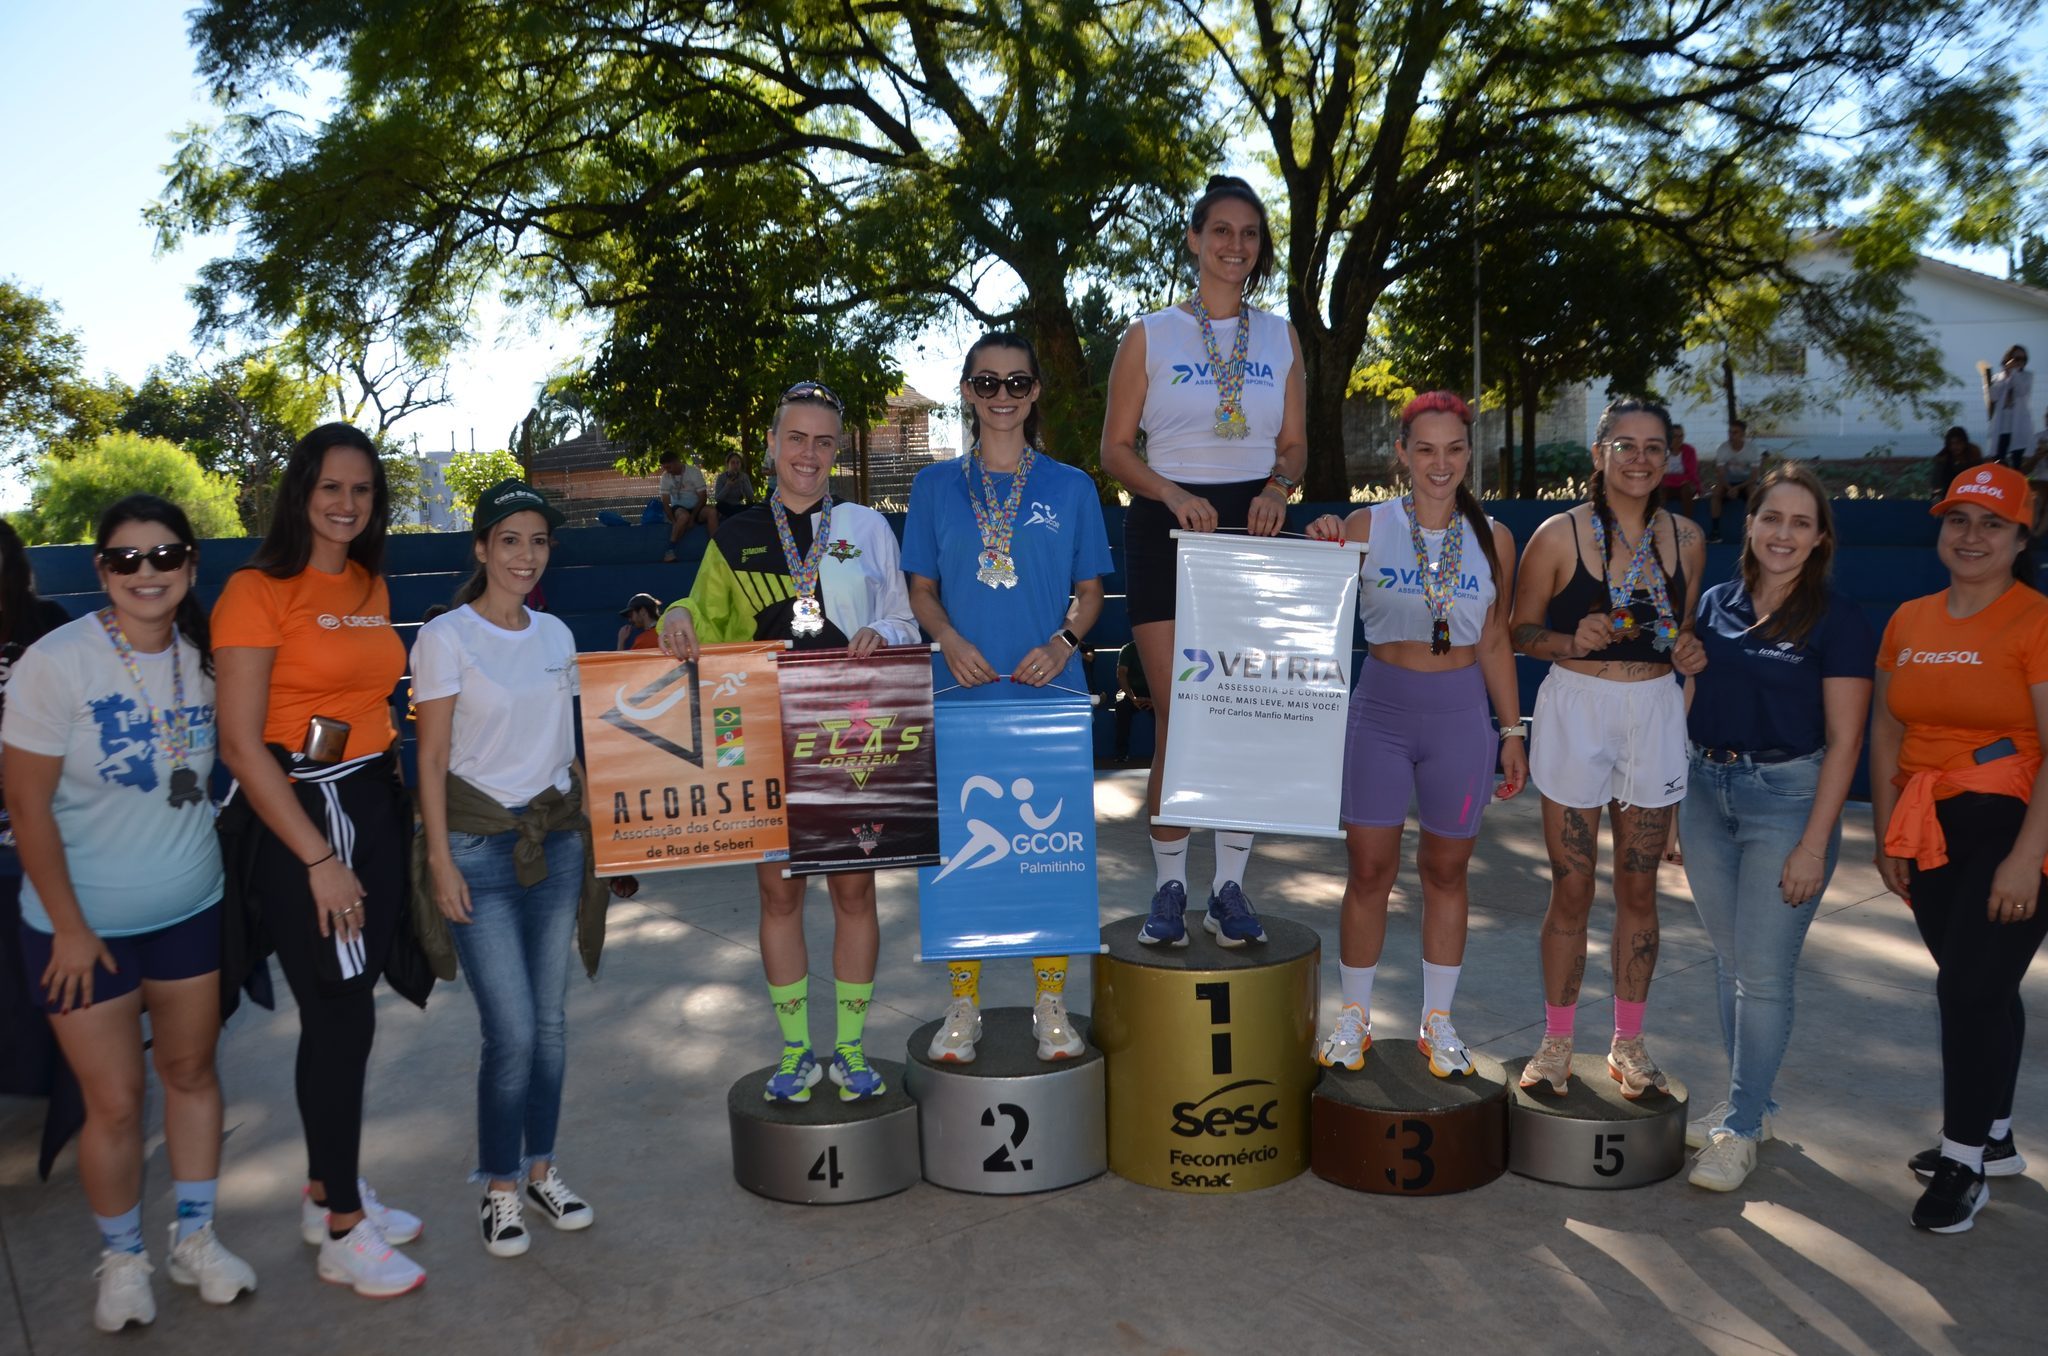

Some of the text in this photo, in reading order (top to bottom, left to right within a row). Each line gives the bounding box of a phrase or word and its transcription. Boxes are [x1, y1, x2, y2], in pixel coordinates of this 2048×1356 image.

[1956, 484, 2005, 500] CRESOL
[1218, 650, 1346, 686] VETRIA
[1912, 651, 1984, 665] CRESOL
[1178, 692, 1199, 701] MAIS
[1201, 694, 1233, 704] LONGE,
[1235, 696, 1258, 705] MAIS
[1260, 698, 1285, 708] LEVE,
[1287, 701, 1310, 710] MAIS
[1217, 682, 1342, 699] ASSESSORIA DE CORRIDA
[1209, 706, 1314, 722] Prof Carlos Manfio Martins
[793, 726, 924, 759] ELAS
[819, 753, 900, 769] CORREM
[613, 778, 783, 825] ACORSEB
[612, 815, 784, 841] Associação dos Corredores
[646, 837, 755, 859] de Rua de Seberi
[1012, 831, 1084, 855] GCOR
[1020, 861, 1086, 874] Palmitinho
[1195, 981, 1232, 1075] 1
[981, 1103, 1034, 1173] 2
[1170, 1145, 1279, 1167] Fecomércio
[1384, 1118, 1436, 1191] 3
[1592, 1134, 1626, 1178] 5
[808, 1145, 844, 1189] 4
[1171, 1171, 1232, 1188] Senac
